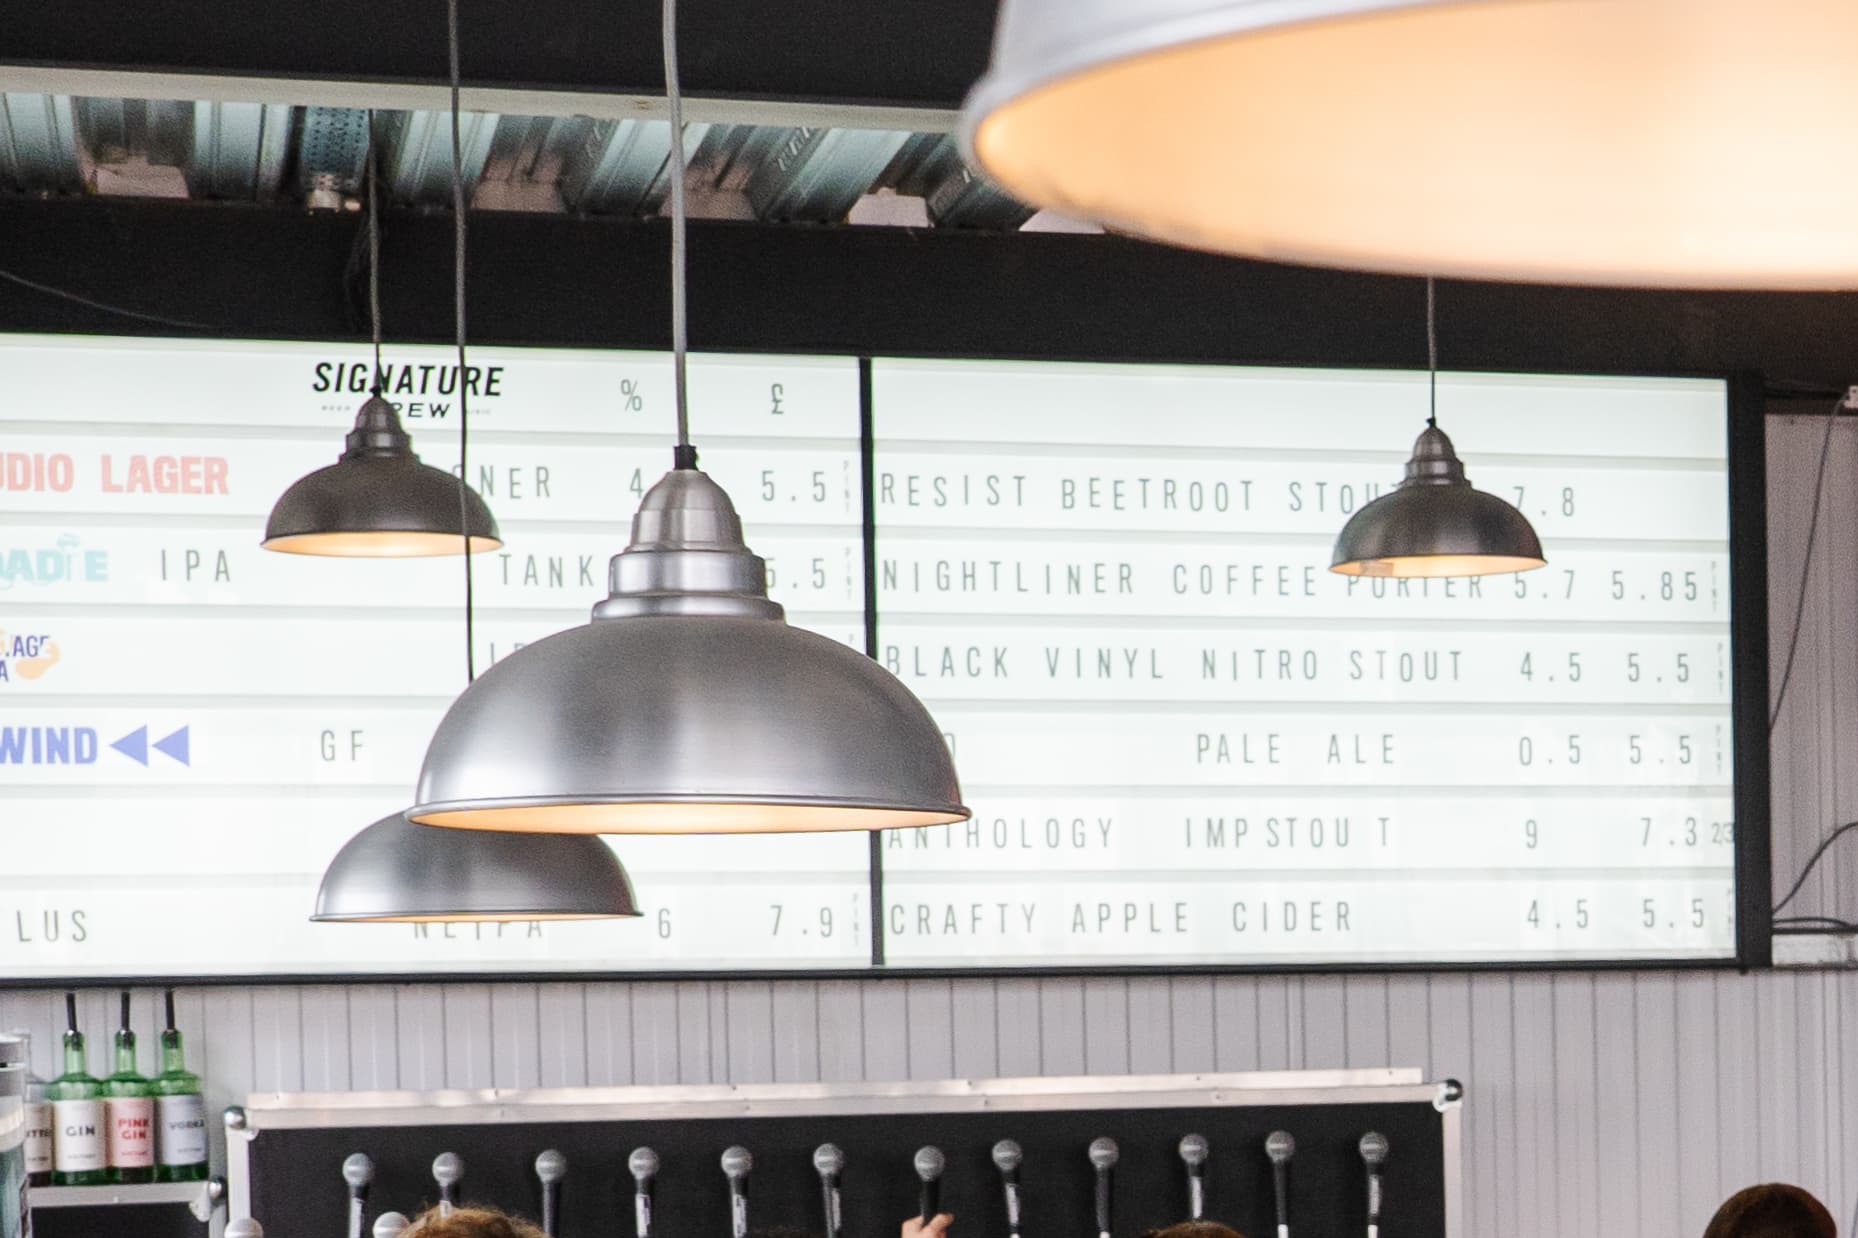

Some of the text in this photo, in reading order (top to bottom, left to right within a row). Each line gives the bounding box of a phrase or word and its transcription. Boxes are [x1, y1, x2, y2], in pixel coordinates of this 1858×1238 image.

[313, 361, 504, 397] SIGNATURE
[620, 378, 785, 416] % £
[0, 452, 229, 495] DIO LAGER
[451, 464, 551, 499] NER
[761, 470, 826, 502] 5.5
[880, 472, 1027, 507] RESIST
[1060, 477, 1254, 512] BEETROOT
[1288, 481, 1400, 514] STOU
[1511, 485, 1576, 517] 7.8
[160, 548, 231, 583] IPA
[499, 553, 595, 589] TANK
[882, 558, 1134, 595] NIGHTLINER
[1172, 563, 1316, 597] COFFEE
[1513, 570, 1576, 600] 5.7
[1611, 570, 1698, 601] 5.85
[886, 644, 1009, 678] BLACK
[1045, 647, 1164, 680] VINYL
[1202, 648, 1318, 682] NITRO
[1349, 650, 1463, 683] STOUT
[1520, 651, 1582, 683] 4.5
[1627, 652, 1690, 684] 5.5
[320, 729, 364, 762] GF
[1196, 733, 1281, 765] PALE
[1327, 734, 1396, 765] ALE
[1518, 734, 1582, 768] 0.5
[1628, 734, 1692, 765] 5.5
[888, 818, 1113, 849] ANTHOLOGY
[1185, 817, 1249, 849] IMP
[1525, 819, 1539, 849] 9
[1641, 817, 1698, 848] 7.3
[16, 909, 87, 943] LUS
[658, 907, 672, 939] 6
[771, 904, 834, 938] 7.9
[890, 903, 1037, 936] CRAFTY
[1070, 902, 1190, 935] APPLE
[1231, 901, 1352, 934] CIDER
[1526, 900, 1589, 929] 4.5
[1642, 899, 1705, 929] 5.5
[66, 1124, 96, 1137] GIN
[121, 1129, 147, 1140] GIN
